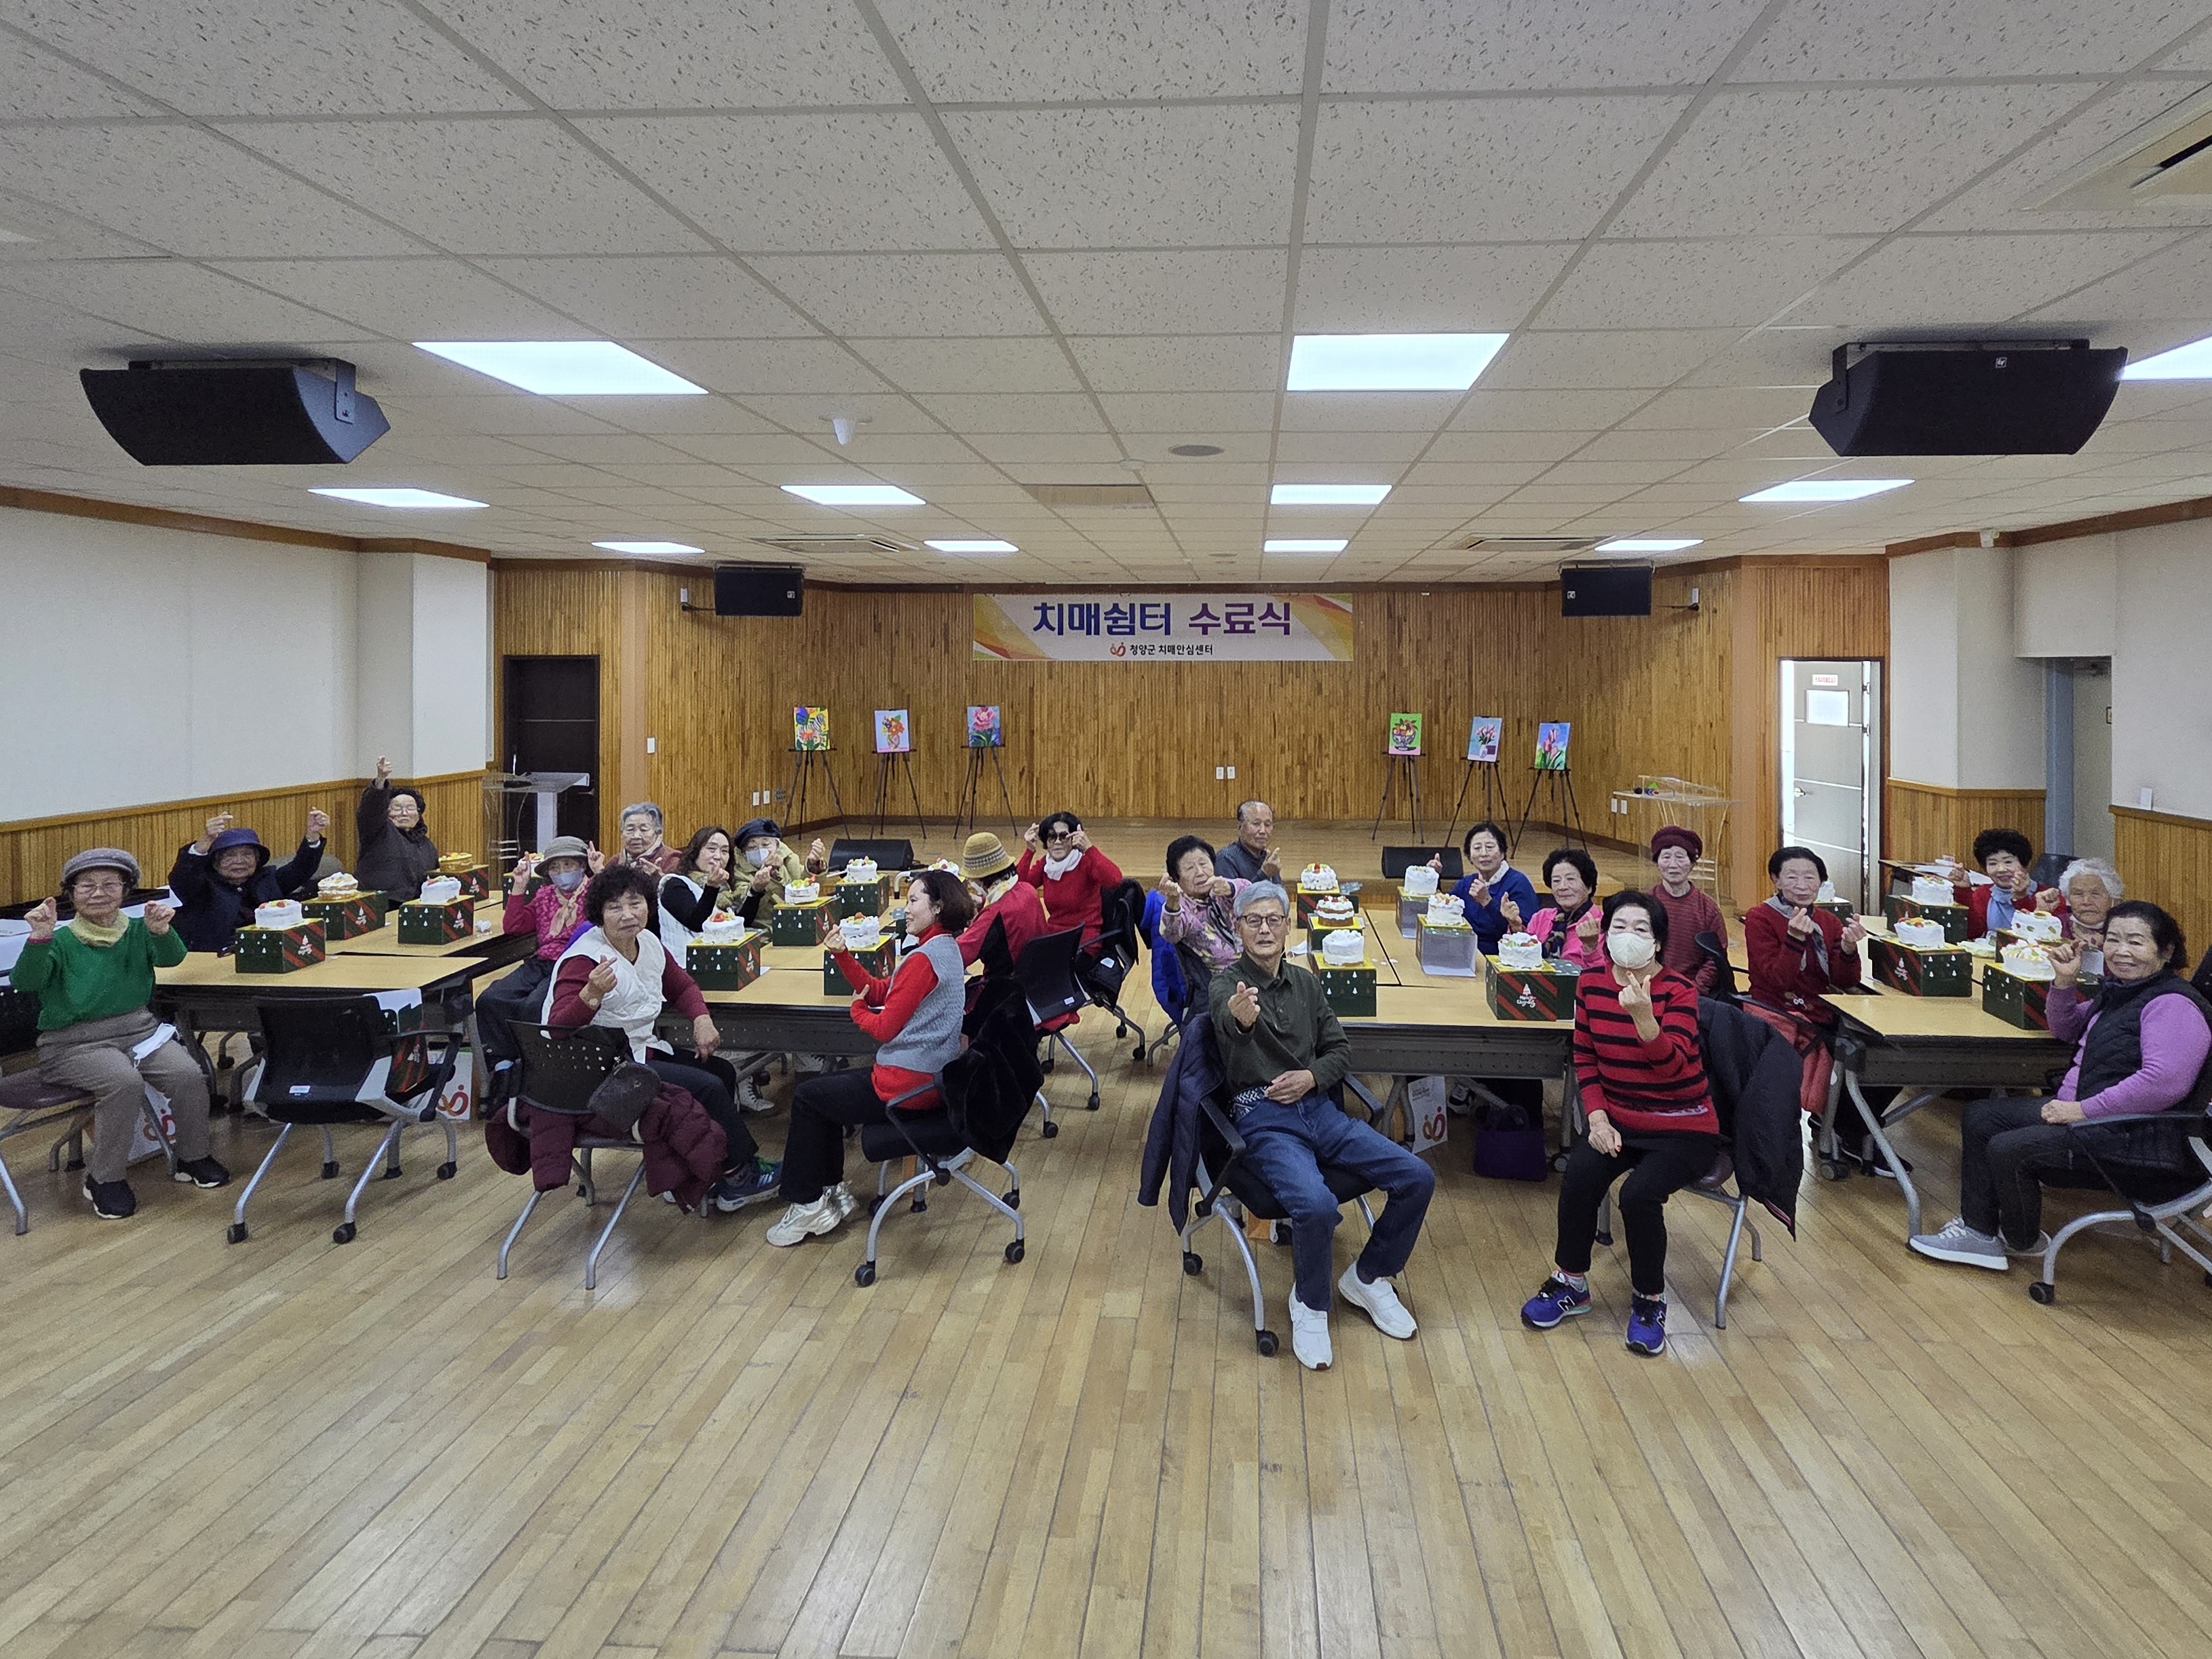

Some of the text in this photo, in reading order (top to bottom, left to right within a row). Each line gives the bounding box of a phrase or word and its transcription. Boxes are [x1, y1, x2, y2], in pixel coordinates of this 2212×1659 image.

[1033, 603, 1290, 636] 치매쉼터 수료식
[1130, 644, 1213, 655] 청양군 치매안심센터
